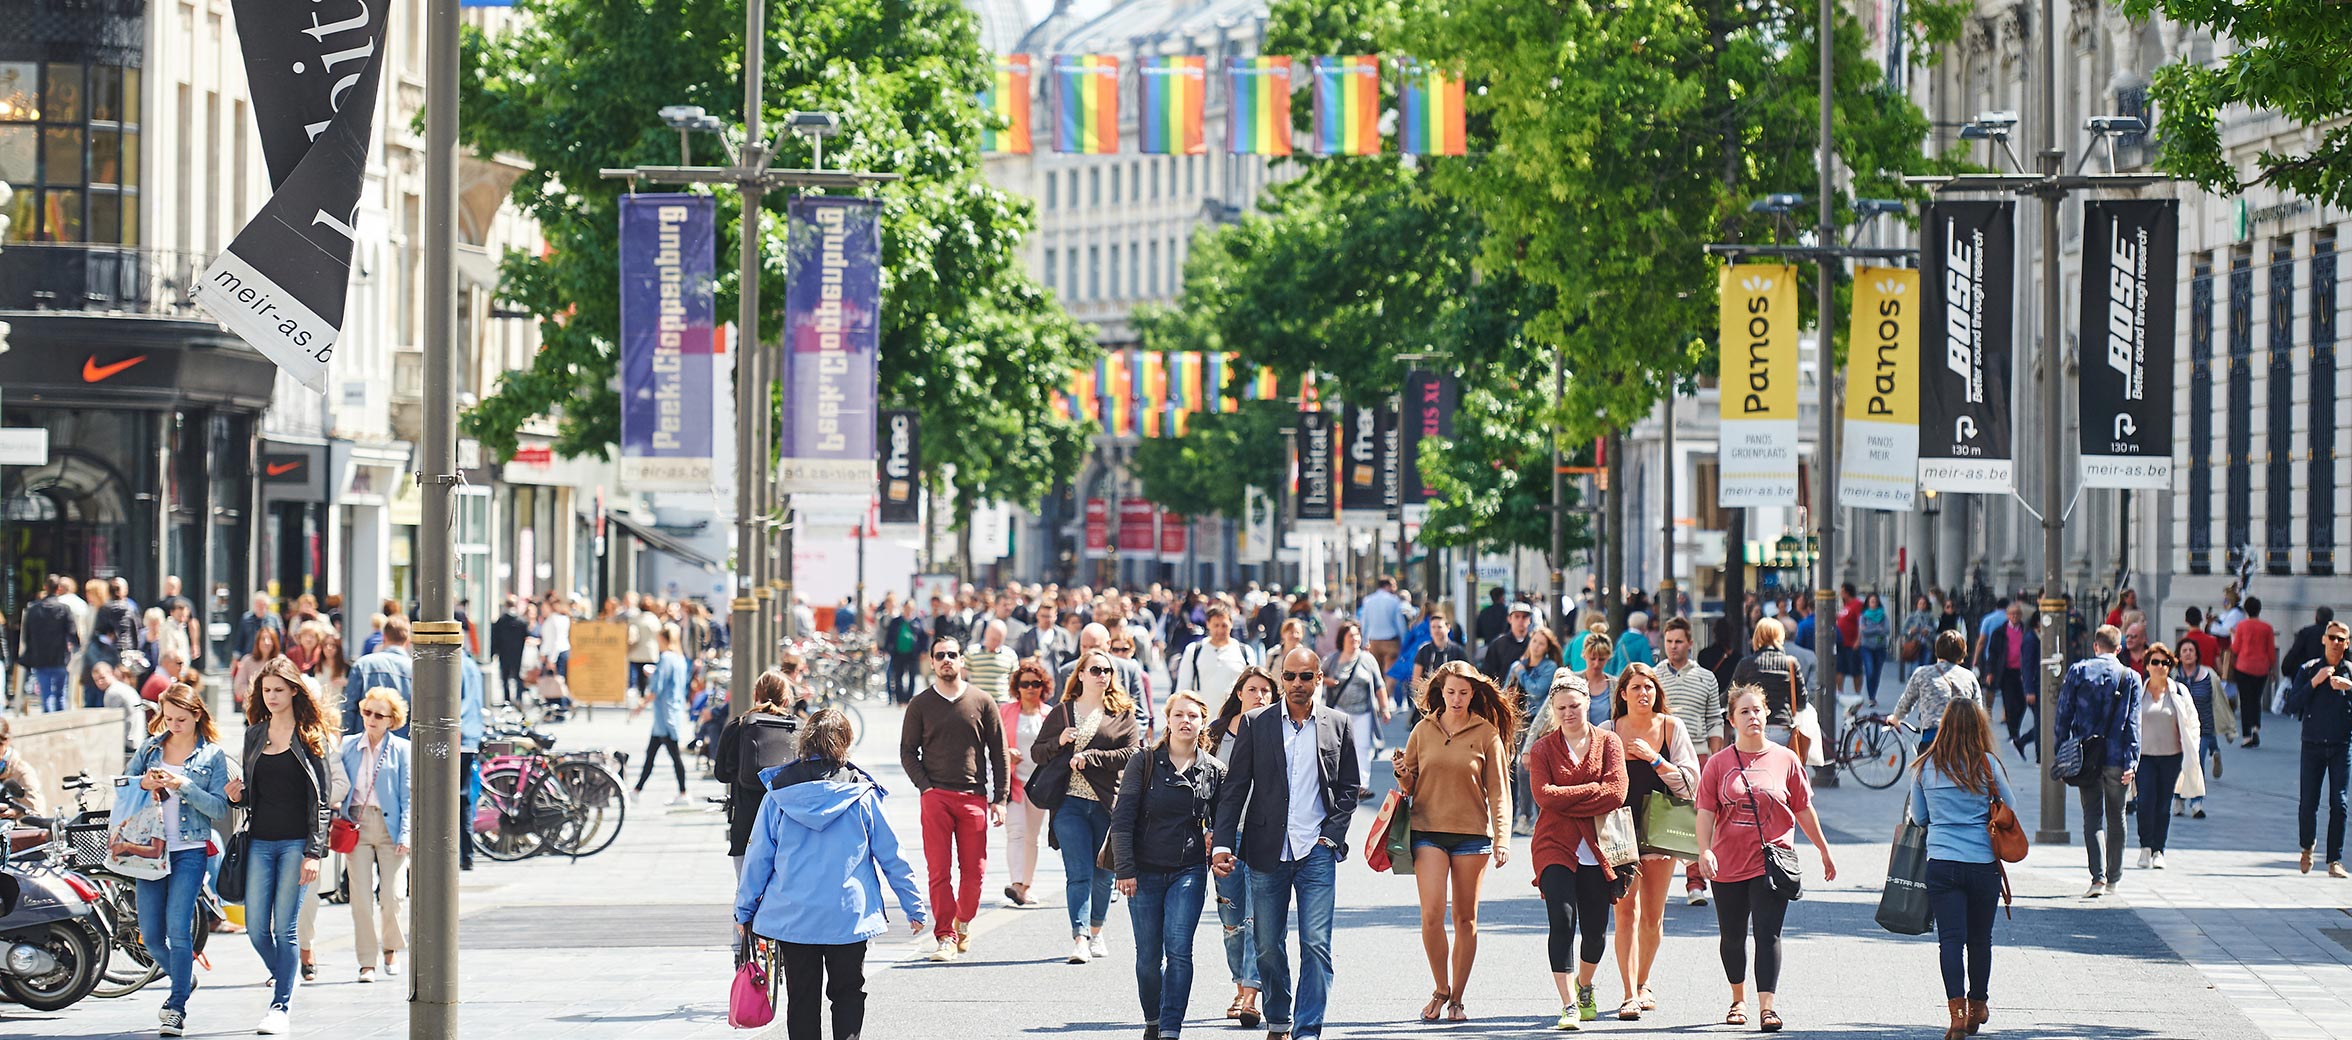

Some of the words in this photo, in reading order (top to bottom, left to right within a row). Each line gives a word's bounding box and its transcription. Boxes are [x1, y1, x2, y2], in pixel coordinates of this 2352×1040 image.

[1973, 231, 1984, 282] research
[2137, 230, 2148, 280] research
[213, 270, 333, 363] meir-as.b
[1947, 219, 1972, 403] BOSE
[1971, 282, 1985, 330] through
[2108, 217, 2136, 400] BOSE
[2135, 280, 2148, 327] through
[1744, 296, 1770, 414] Panos
[1867, 300, 1900, 416] Panos
[1972, 329, 1982, 366] sound
[2134, 325, 2145, 363] sound
[1423, 379, 1442, 404] XL
[1972, 366, 1983, 404] Better
[2132, 363, 2144, 400] Better
[887, 414, 910, 477] fnac
[1731, 447, 1788, 459] GROENPLAATS
[1745, 434, 1773, 445] PANOS
[1867, 436, 1894, 447] PANOS
[1869, 449, 1890, 461] MEIR
[1952, 444, 1970, 456] 130
[1970, 447, 1982, 456] m
[2111, 442, 2127, 453] 130
[2128, 444, 2140, 453] m
[1303, 428, 1328, 505] habitat
[1924, 466, 2008, 481] meir-as.be
[2087, 463, 2167, 477] meir-as.be
[1724, 484, 1794, 497] meir-as.be
[1843, 486, 1911, 500] meir-as.be
[1913, 881, 1928, 890] RA
